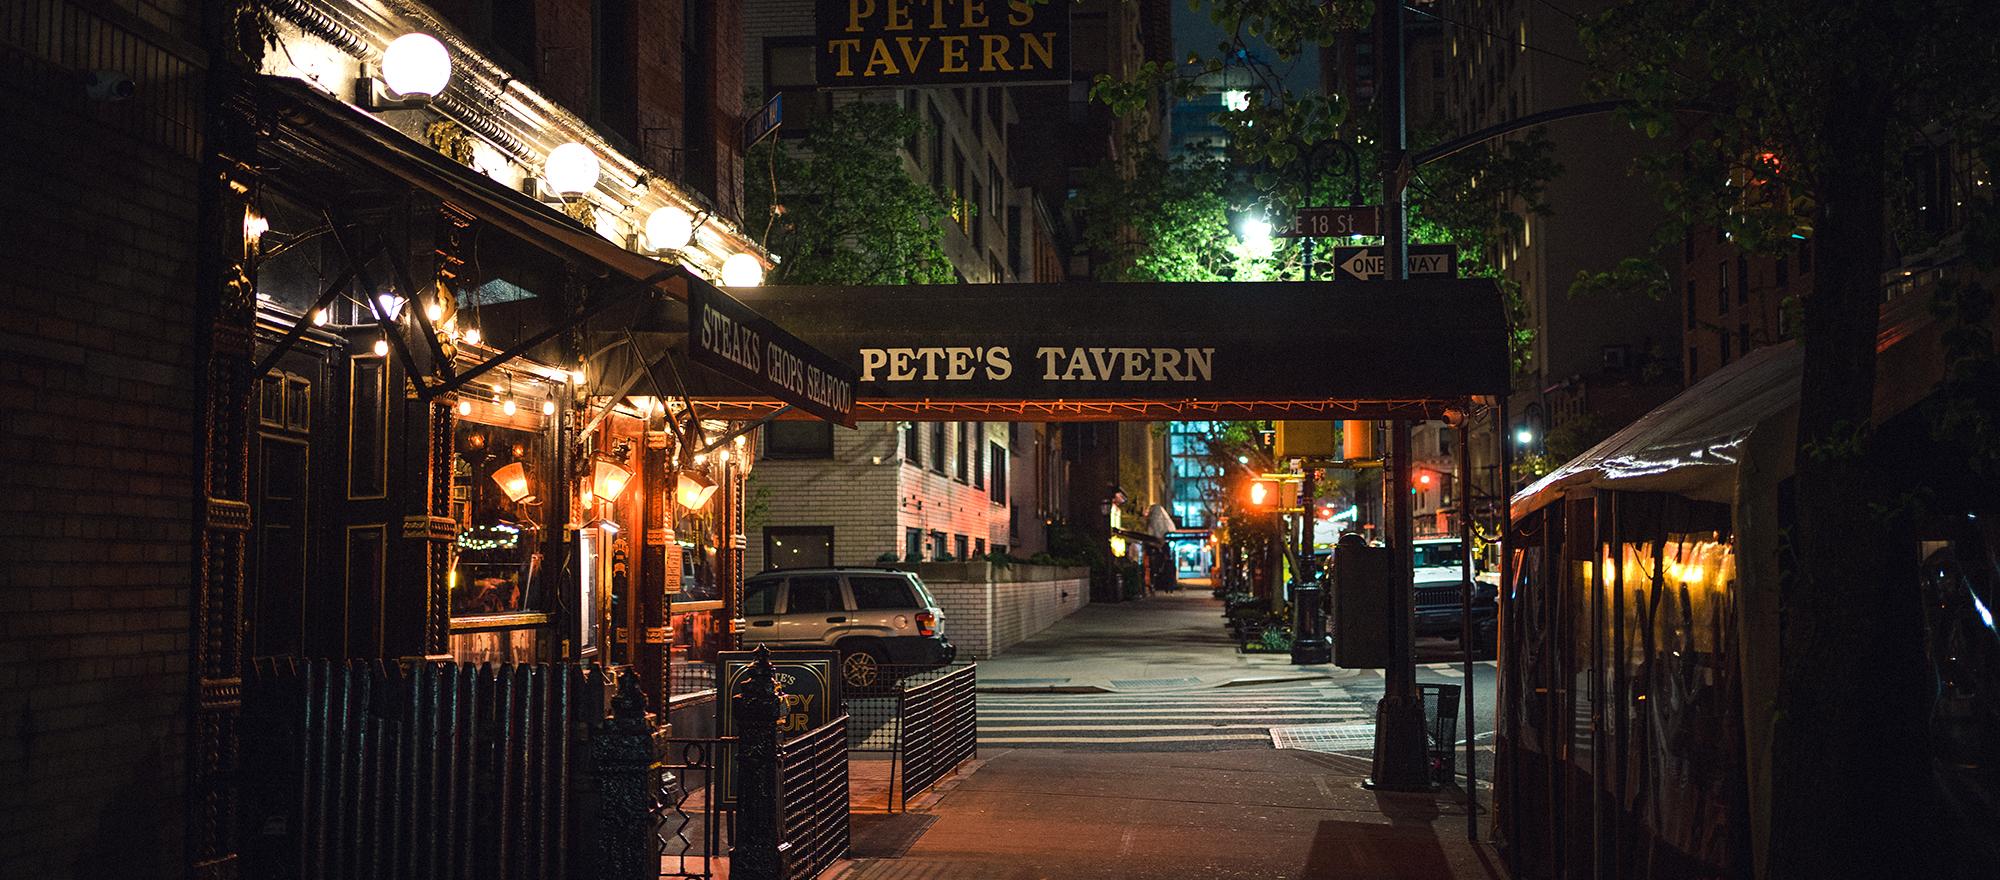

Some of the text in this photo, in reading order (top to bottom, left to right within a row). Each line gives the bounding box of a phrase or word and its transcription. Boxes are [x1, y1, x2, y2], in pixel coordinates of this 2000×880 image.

[844, 0, 1036, 32] PETES
[828, 32, 1057, 77] TAVERN
[1295, 214, 1354, 234] E 18 St
[1353, 258, 1385, 273] ONE
[702, 303, 851, 414] STEAKS CHOPS SEAFOOD
[859, 346, 1215, 382] PETE'S TAVERN
[775, 672, 797, 685] TE'S
